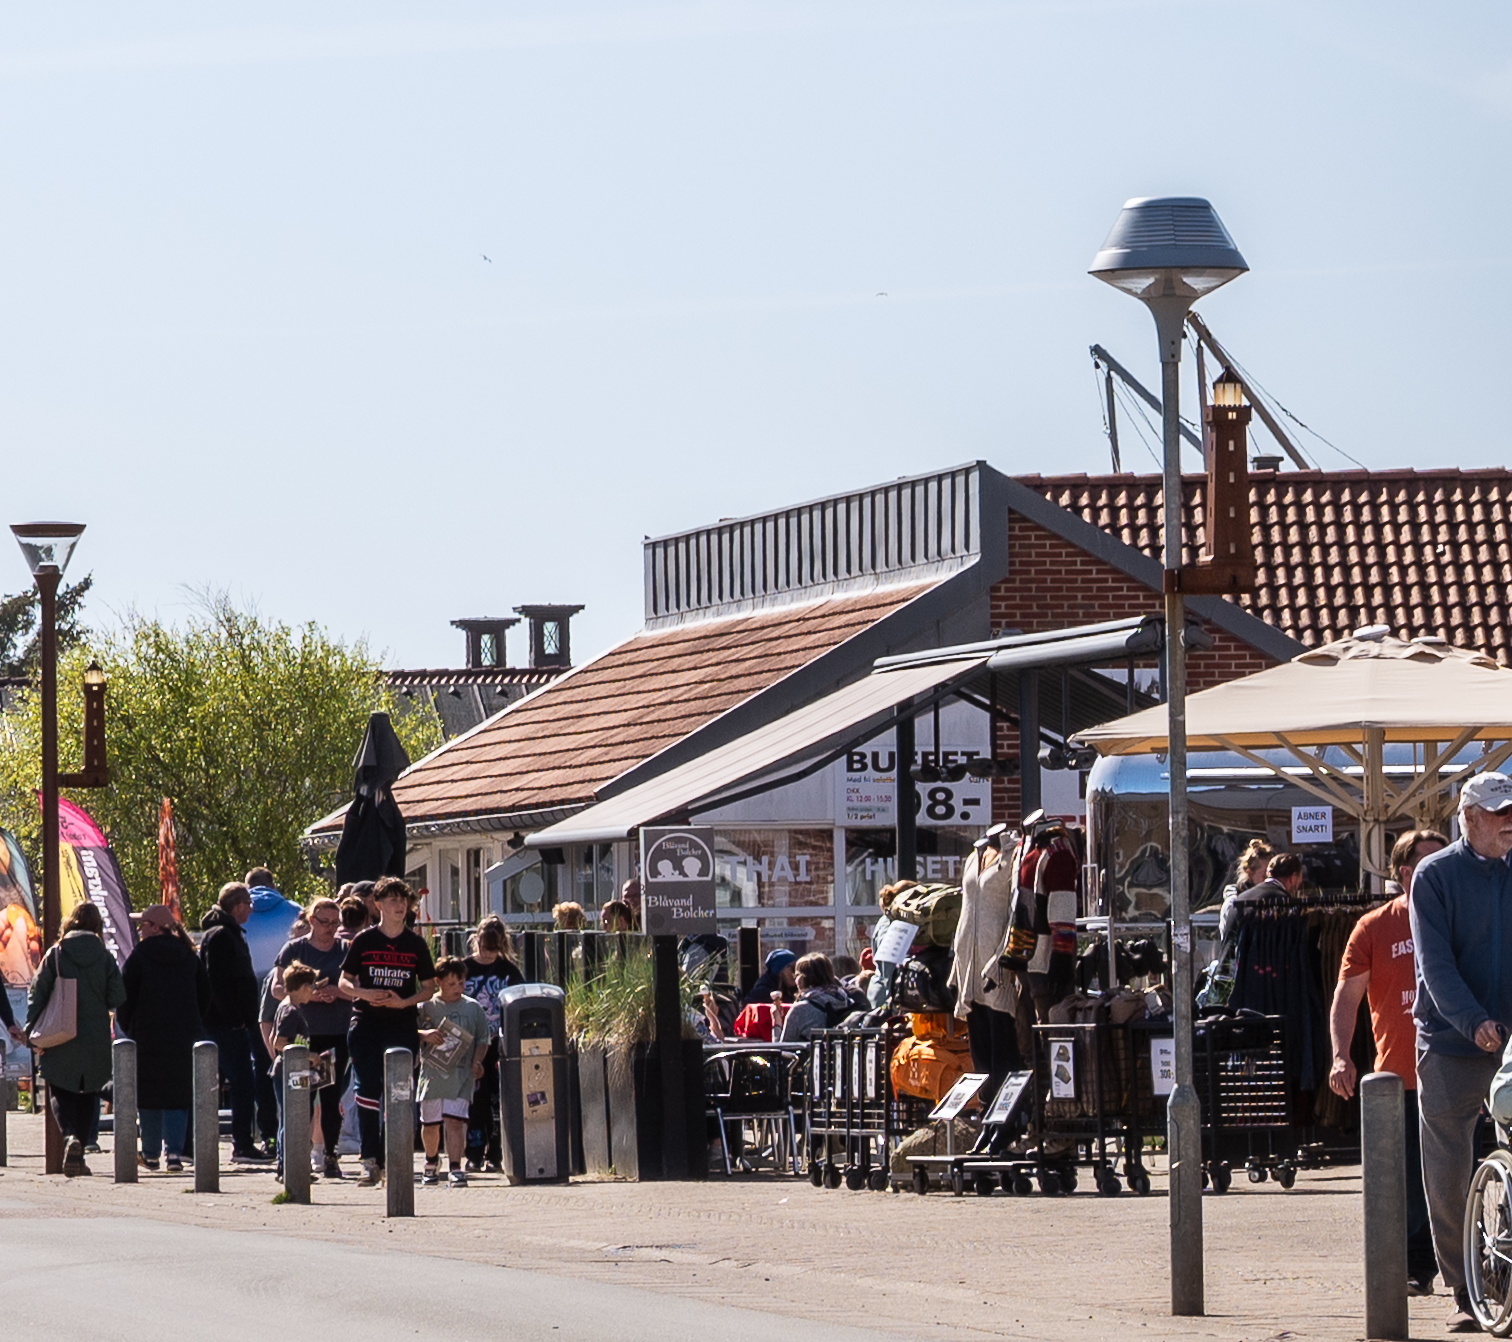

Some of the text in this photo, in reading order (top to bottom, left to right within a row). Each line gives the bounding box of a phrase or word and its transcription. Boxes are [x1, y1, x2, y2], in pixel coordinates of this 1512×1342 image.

[724, 855, 810, 882] THAI
[647, 894, 693, 908] Blåvand
[671, 906, 714, 919] Bolcher
[1391, 939, 1414, 958] EAS
[369, 966, 410, 979] Emirates
